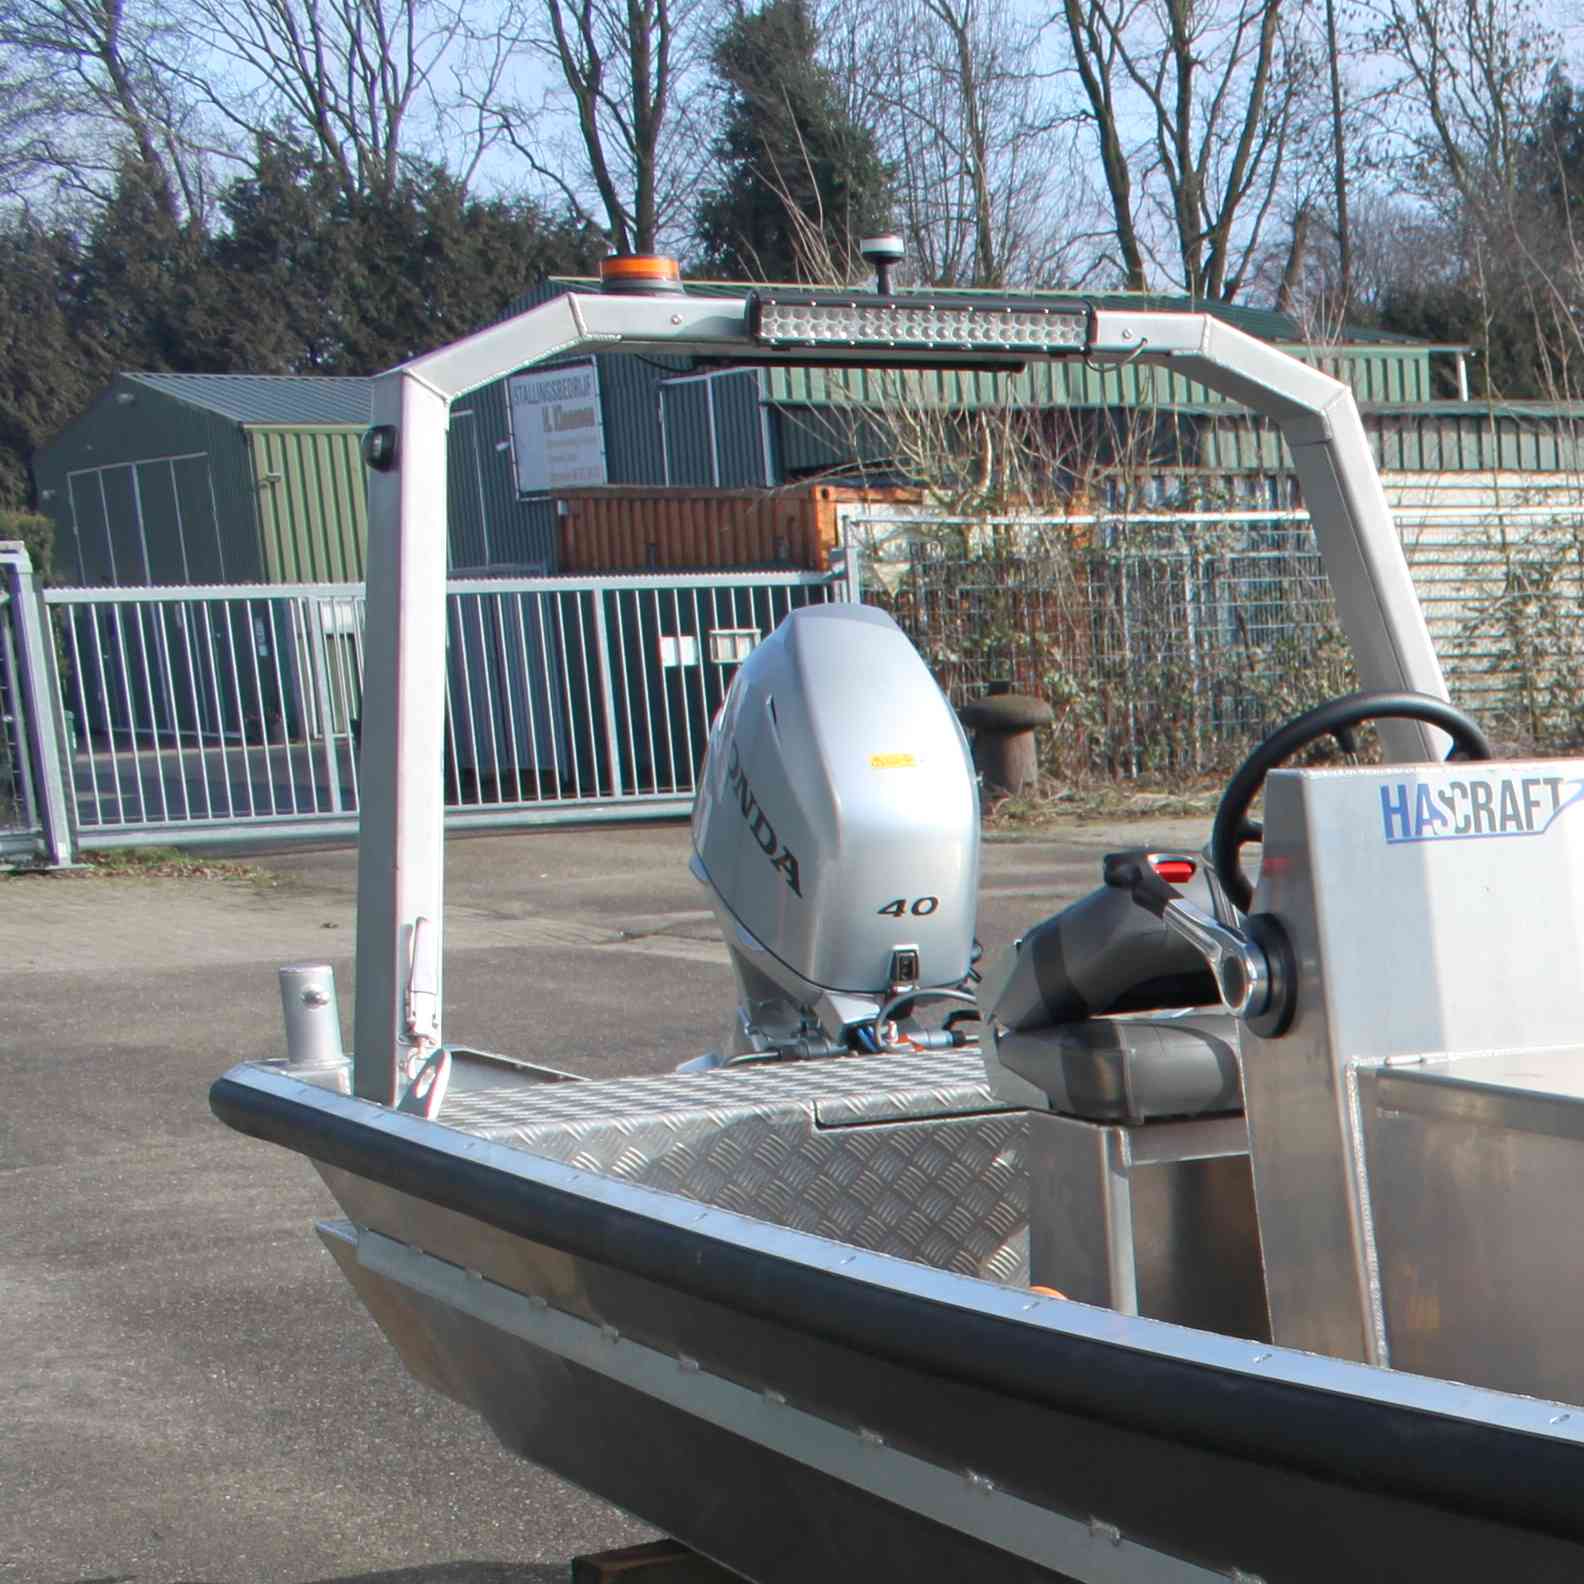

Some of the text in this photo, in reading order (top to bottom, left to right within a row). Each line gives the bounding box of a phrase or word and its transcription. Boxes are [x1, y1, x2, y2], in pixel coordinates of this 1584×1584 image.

[728, 737, 803, 899] ONDA
[1379, 777, 1565, 839] HASCRAFT
[877, 896, 939, 918] 40
